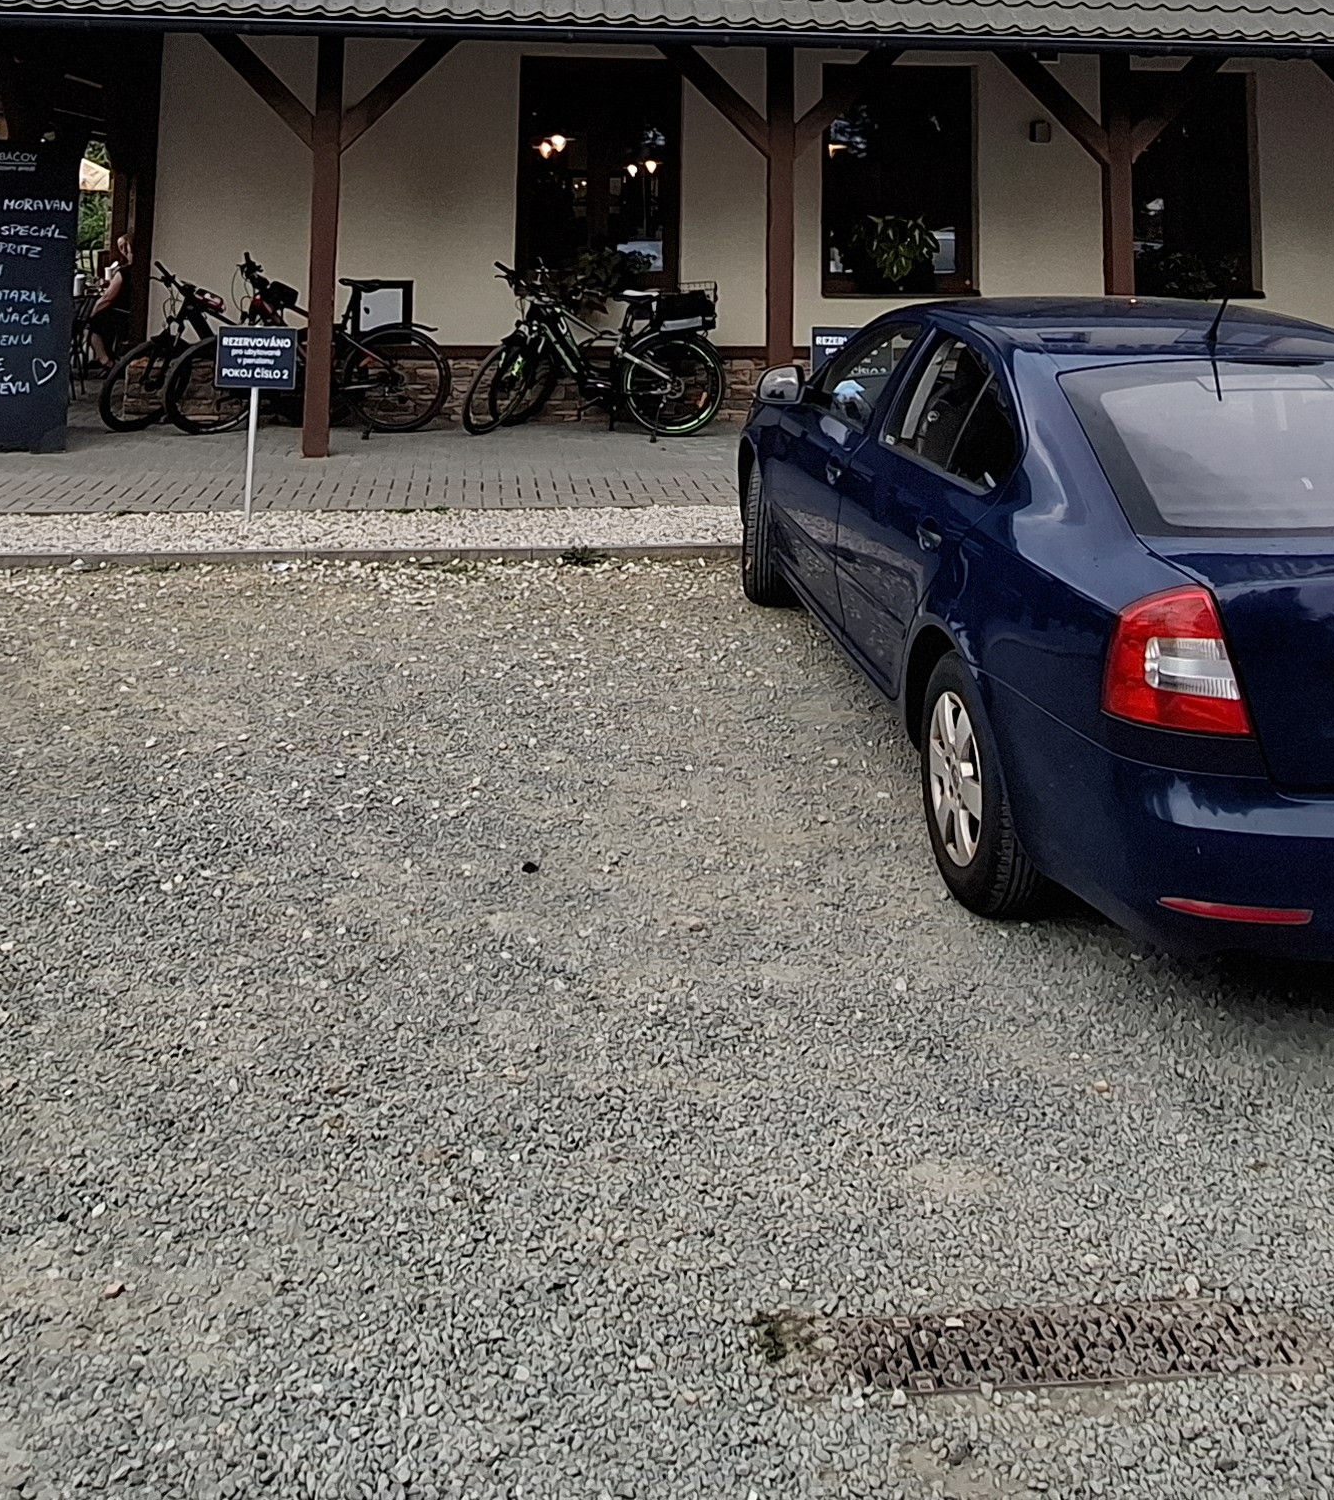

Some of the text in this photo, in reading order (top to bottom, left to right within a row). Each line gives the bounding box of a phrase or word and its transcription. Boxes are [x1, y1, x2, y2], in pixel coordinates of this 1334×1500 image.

[3, 198, 73, 211] MORAVAN
[222, 336, 291, 348] REZERVOVÁNO
[222, 367, 289, 379] POKOJ ČÍSLO 2
